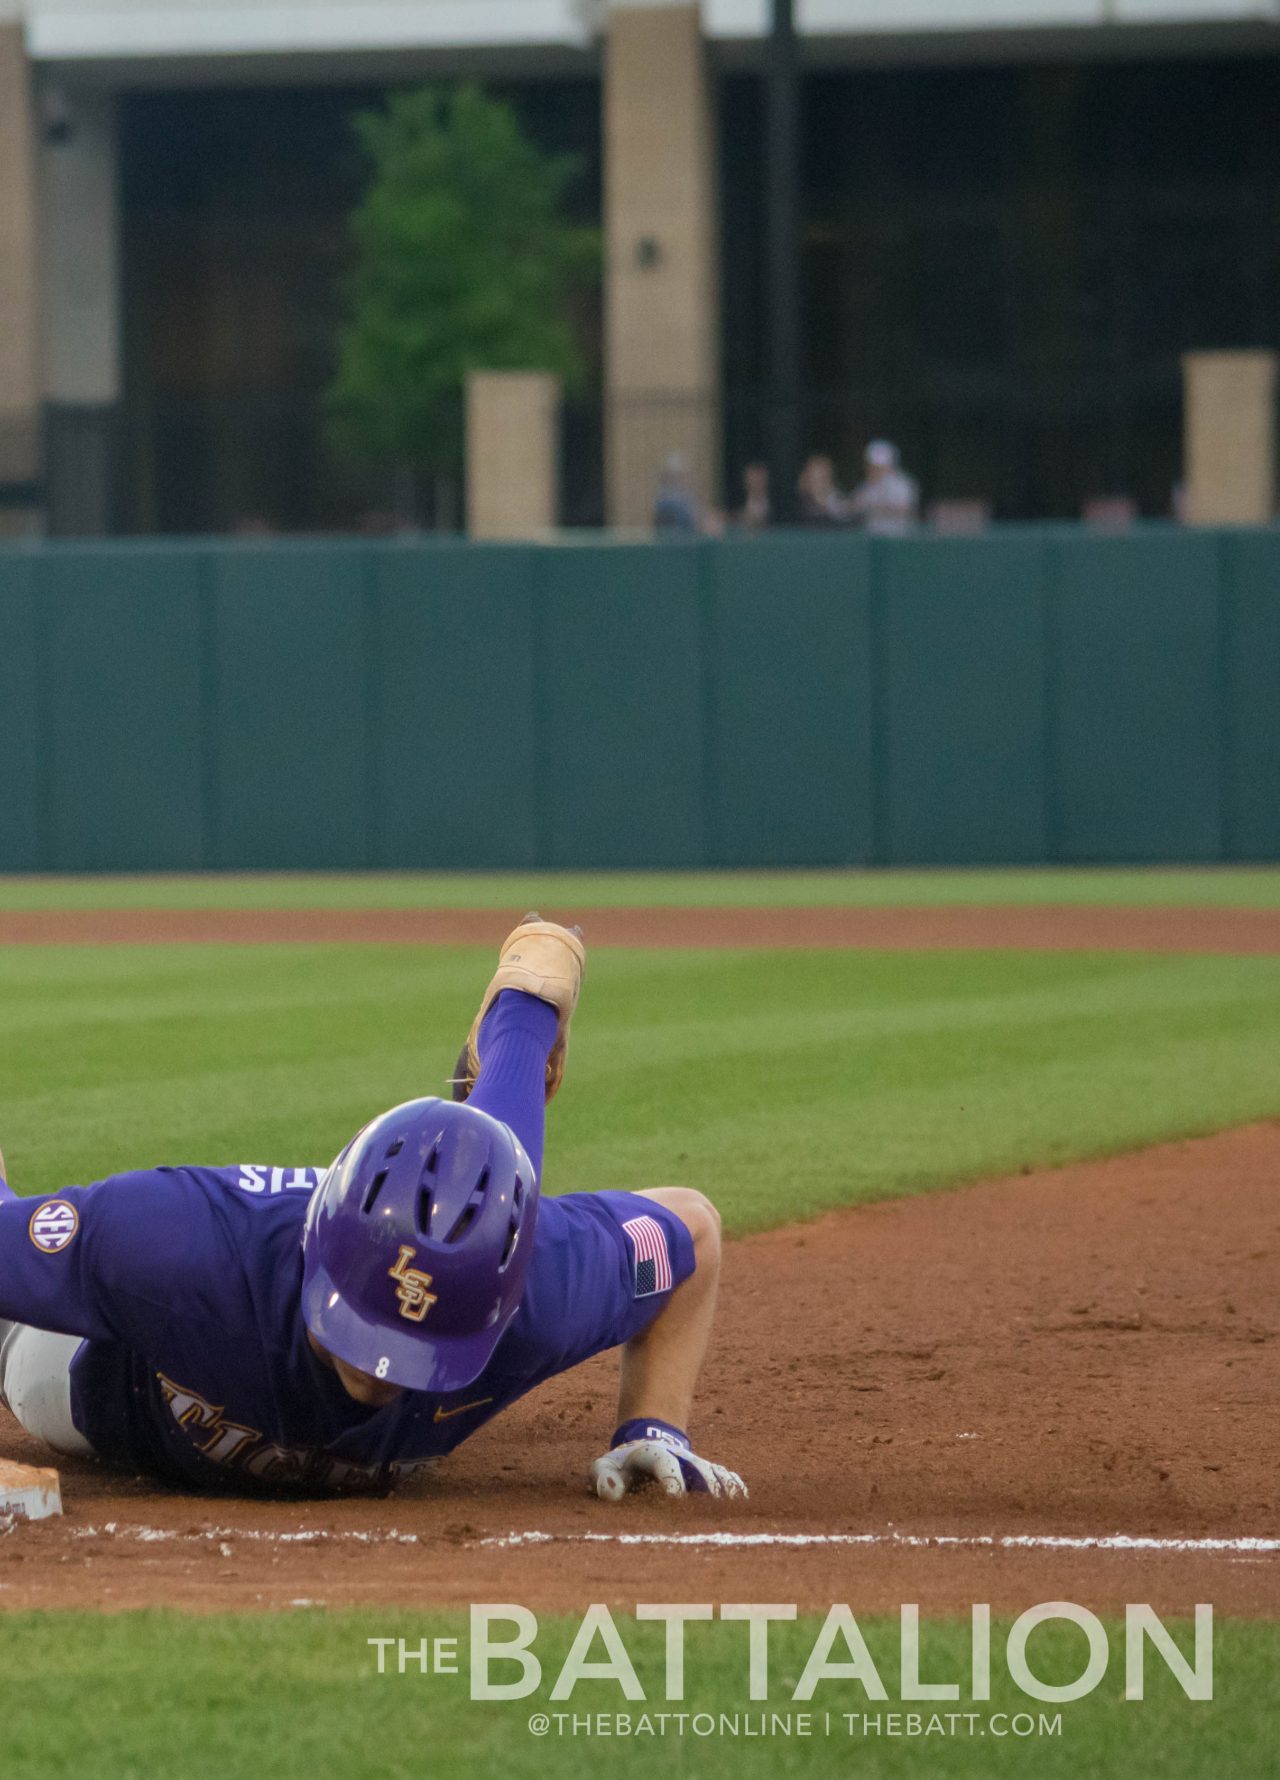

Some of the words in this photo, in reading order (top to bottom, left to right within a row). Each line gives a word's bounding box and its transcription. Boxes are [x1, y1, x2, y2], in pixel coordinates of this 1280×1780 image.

[32, 1204, 76, 1249] SEC
[388, 1245, 437, 1322] LSU
[375, 1357, 390, 1379] 8
